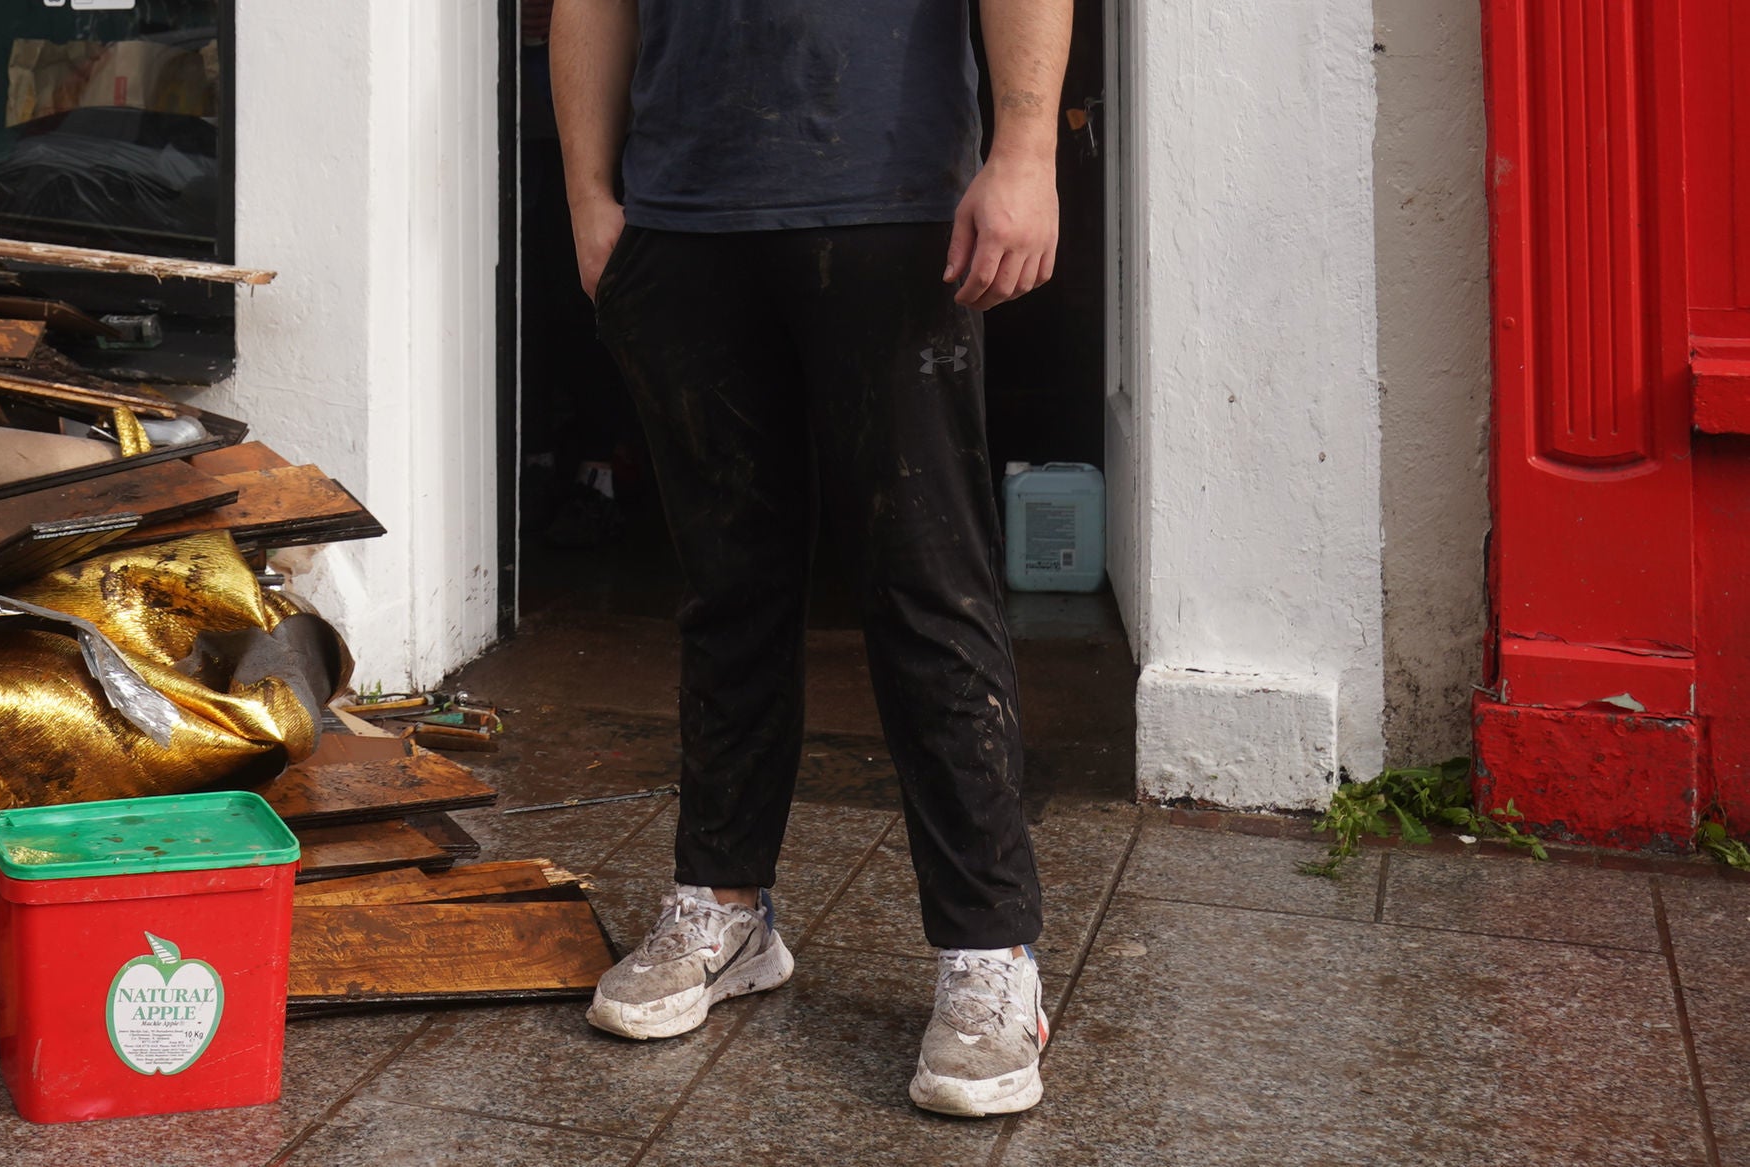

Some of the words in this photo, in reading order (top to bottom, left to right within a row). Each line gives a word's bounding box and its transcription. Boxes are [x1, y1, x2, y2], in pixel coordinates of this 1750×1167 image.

[118, 988, 215, 1003] NATURAL
[131, 1005, 196, 1020] APPLE
[194, 1031, 204, 1039] Kg
